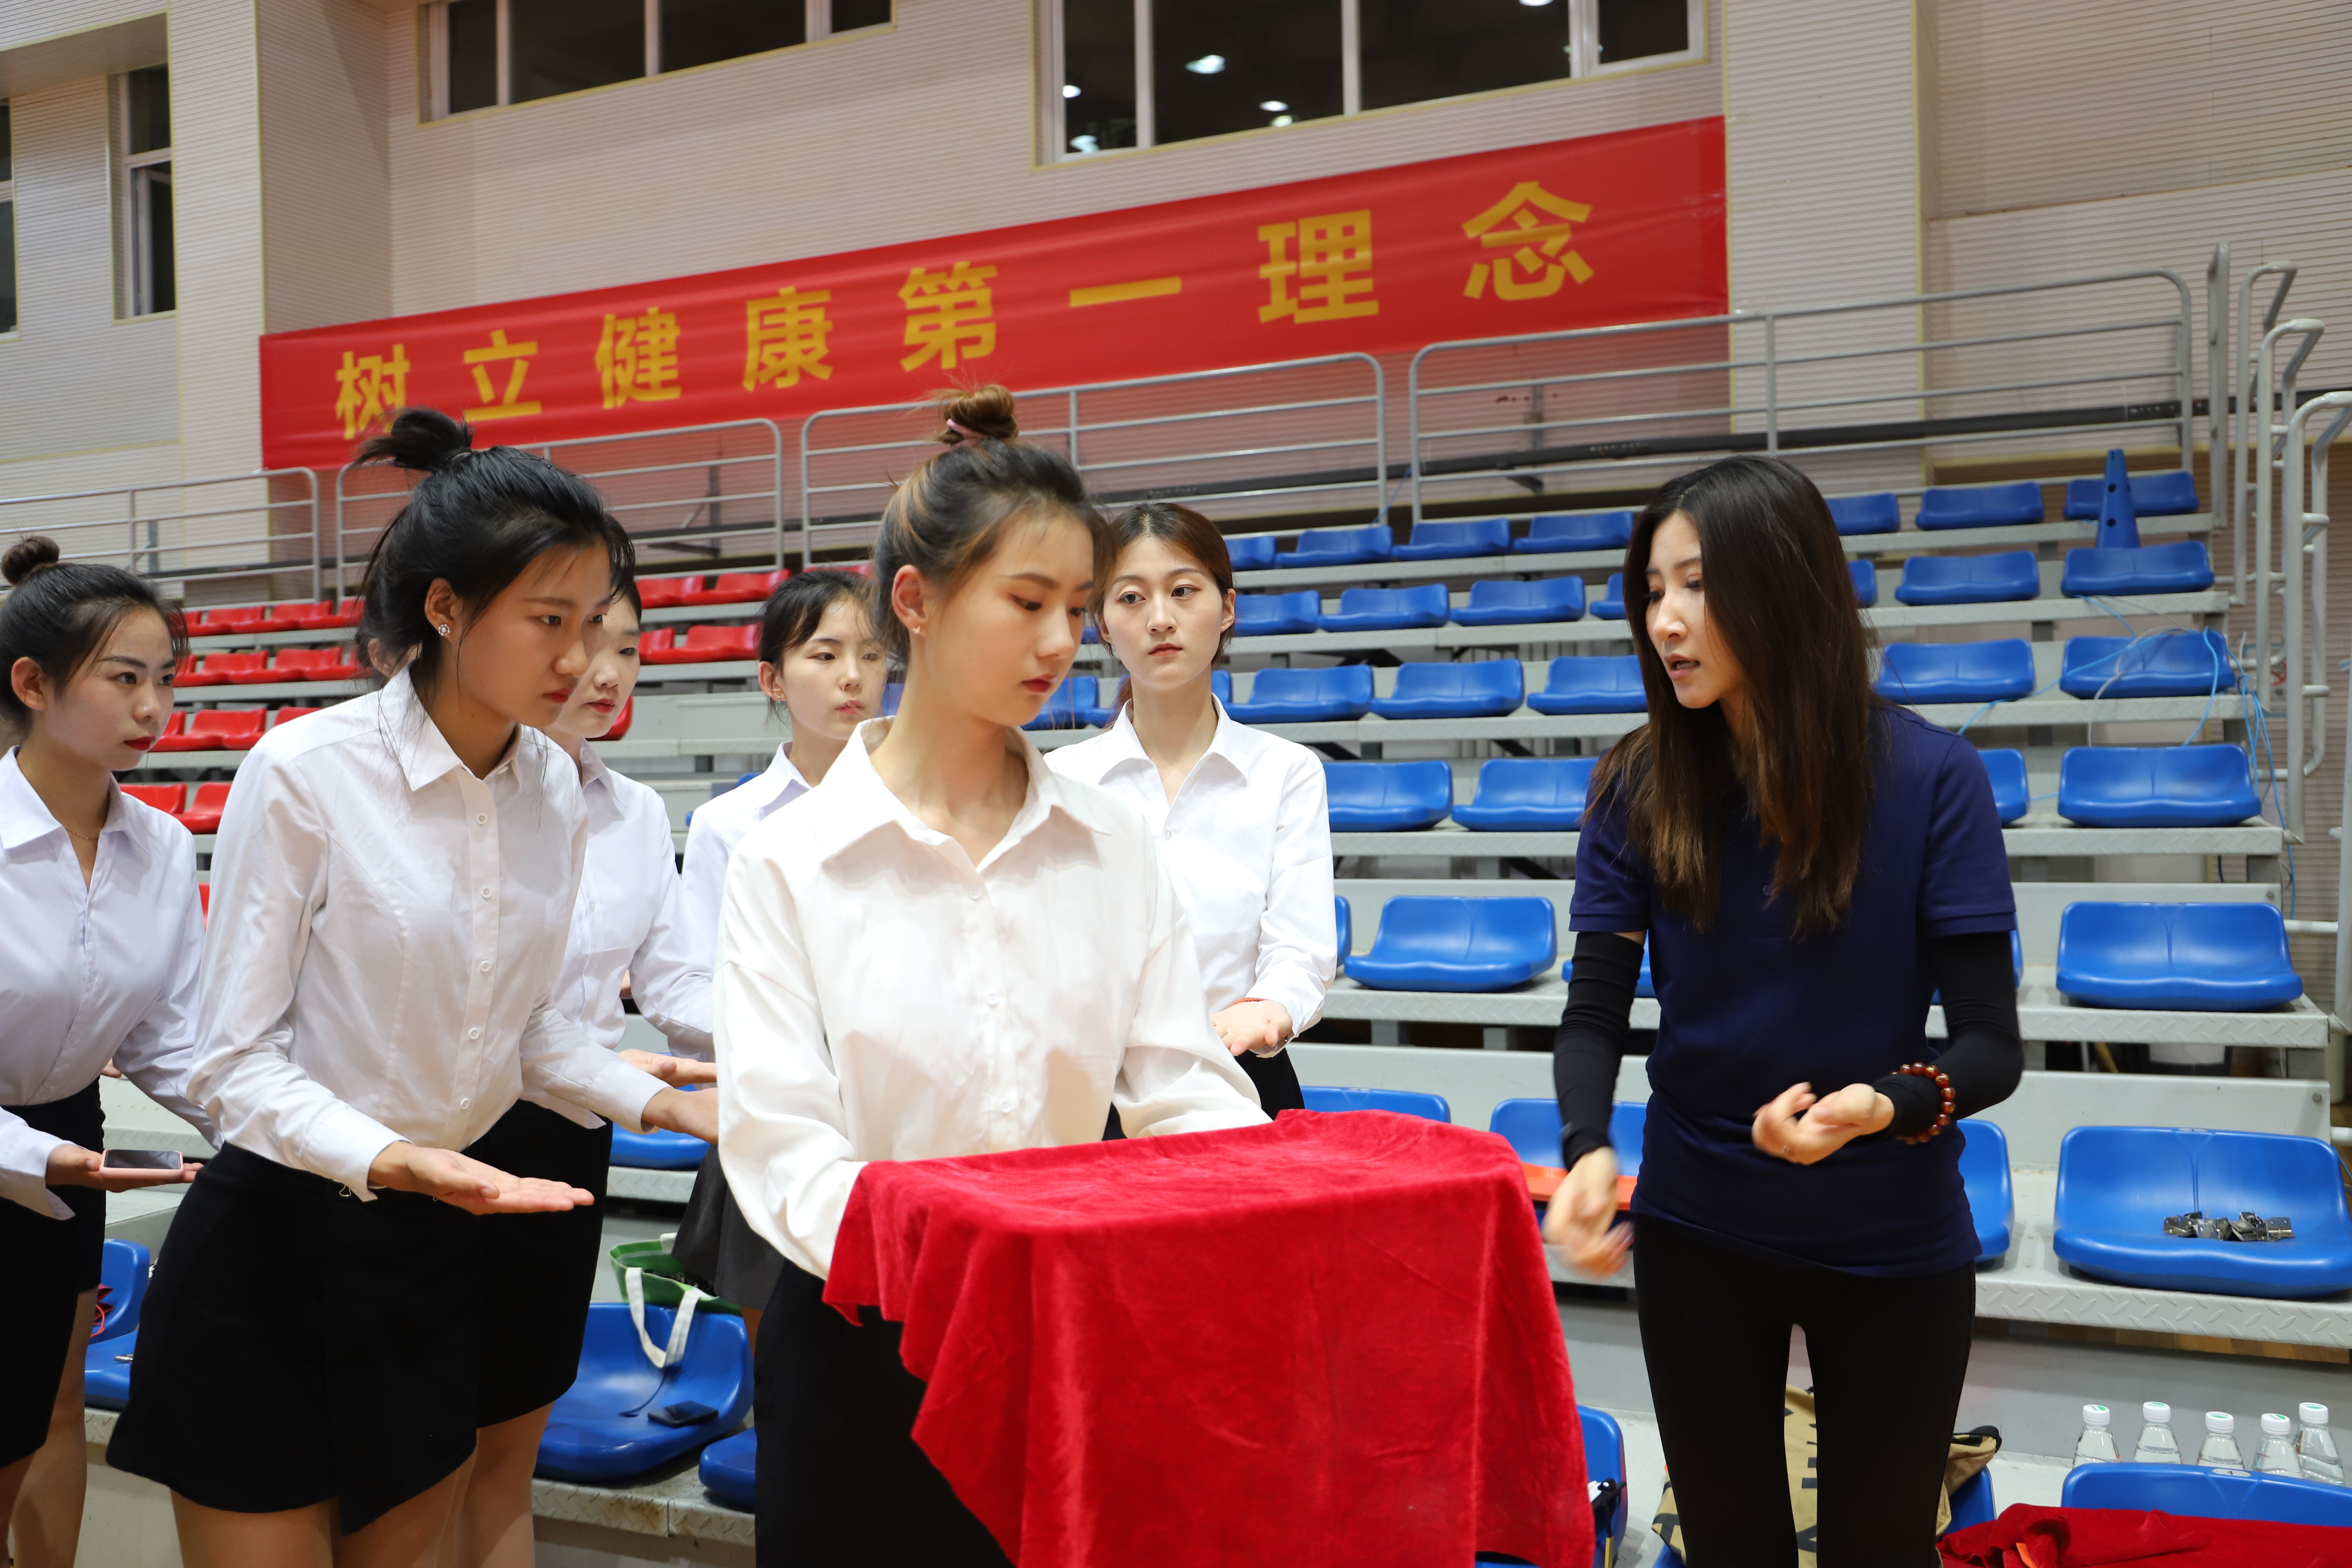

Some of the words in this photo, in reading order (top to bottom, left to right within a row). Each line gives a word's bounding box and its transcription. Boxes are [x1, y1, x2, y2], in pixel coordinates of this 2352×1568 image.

[335, 181, 1594, 440] 树立健康第一理念
